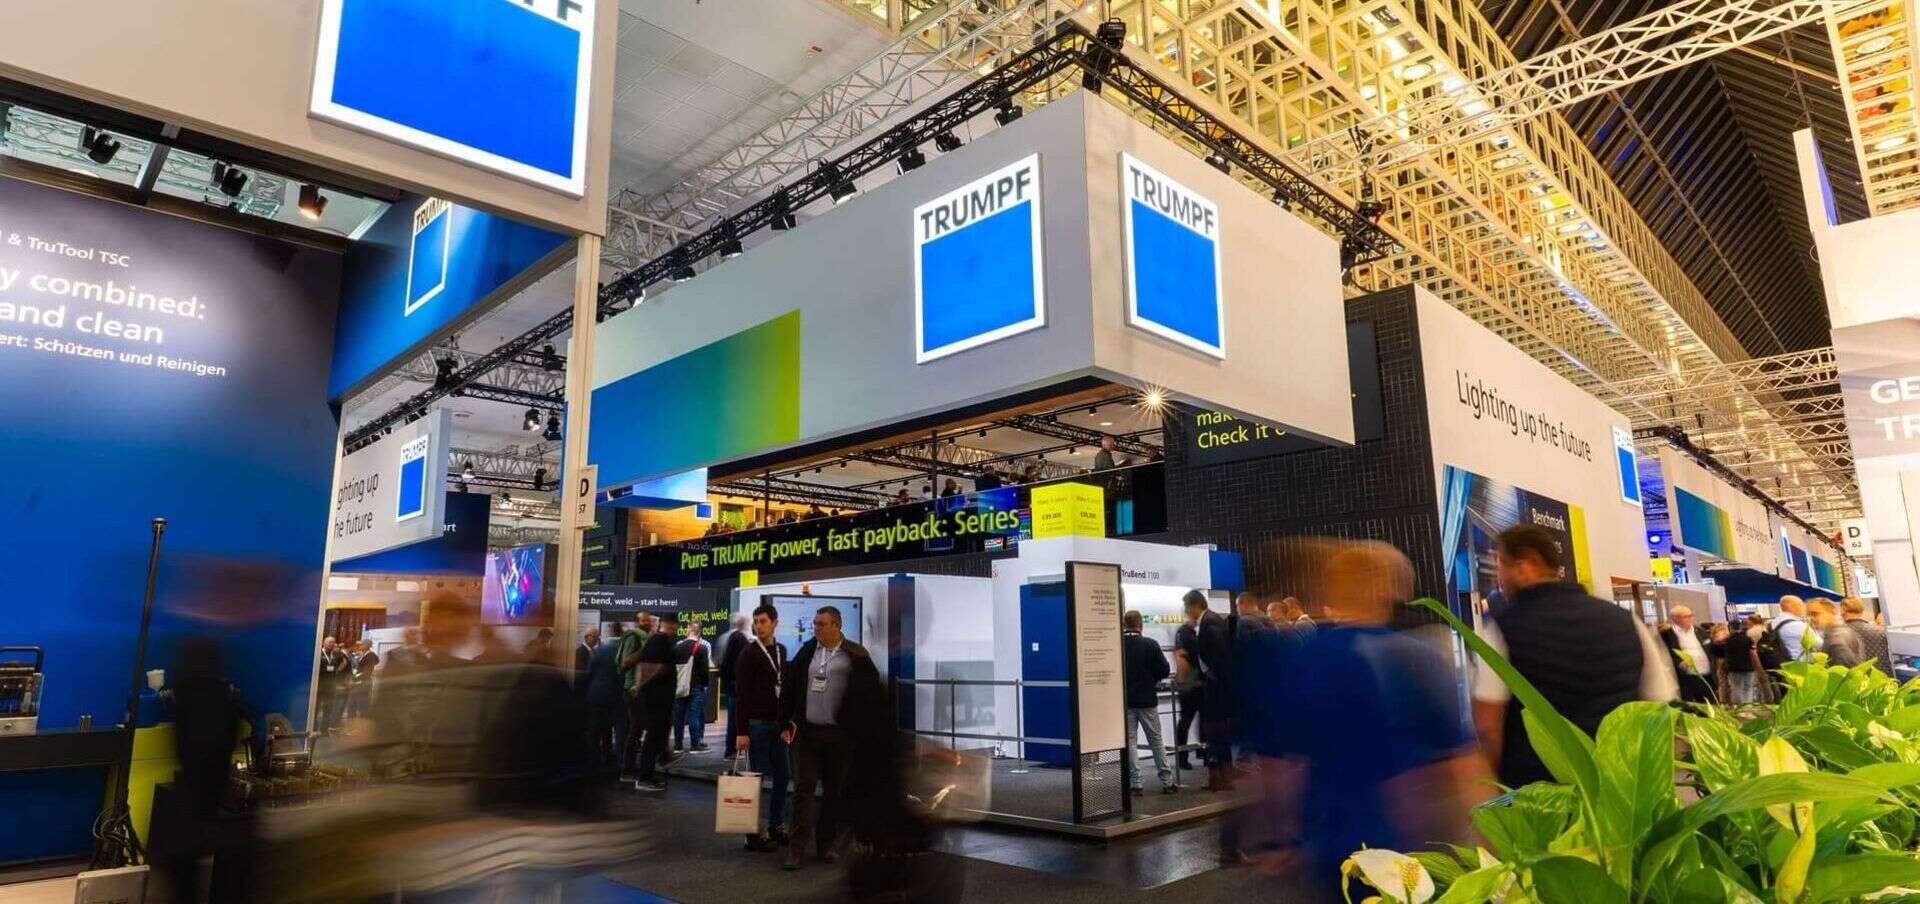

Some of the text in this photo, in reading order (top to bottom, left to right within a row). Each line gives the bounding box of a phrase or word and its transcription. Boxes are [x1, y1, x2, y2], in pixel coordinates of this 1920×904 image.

[921, 166, 1031, 239] TRUMPF
[1129, 165, 1214, 234] TRUMPF
[8, 232, 21, 246] &
[28, 235, 94, 261] TruTool
[99, 251, 131, 268] TSC
[30, 274, 206, 319] combined:
[76, 312, 163, 344] clean
[34, 338, 114, 360] Schützen
[119, 352, 152, 366] und
[156, 356, 226, 377] Reinigen
[1456, 369, 1592, 462] Lighting up the future
[1198, 423, 1269, 449] Check it
[367, 473, 379, 497] up
[580, 478, 589, 497] D
[346, 512, 373, 536] future
[1531, 507, 1566, 531] Benchmark
[1848, 526, 1861, 538] D
[681, 552, 709, 570] Pure
[711, 540, 767, 566] TRUMPF
[770, 537, 822, 564] power,
[827, 528, 859, 551] fast
[864, 513, 948, 552] payback:
[954, 505, 1020, 535] Series
[590, 597, 612, 606] bend,
[615, 597, 633, 606] weld
[641, 598, 657, 606] start
[660, 598, 678, 606] here!
[692, 610, 709, 622] bend,
[711, 608, 727, 620] weld
